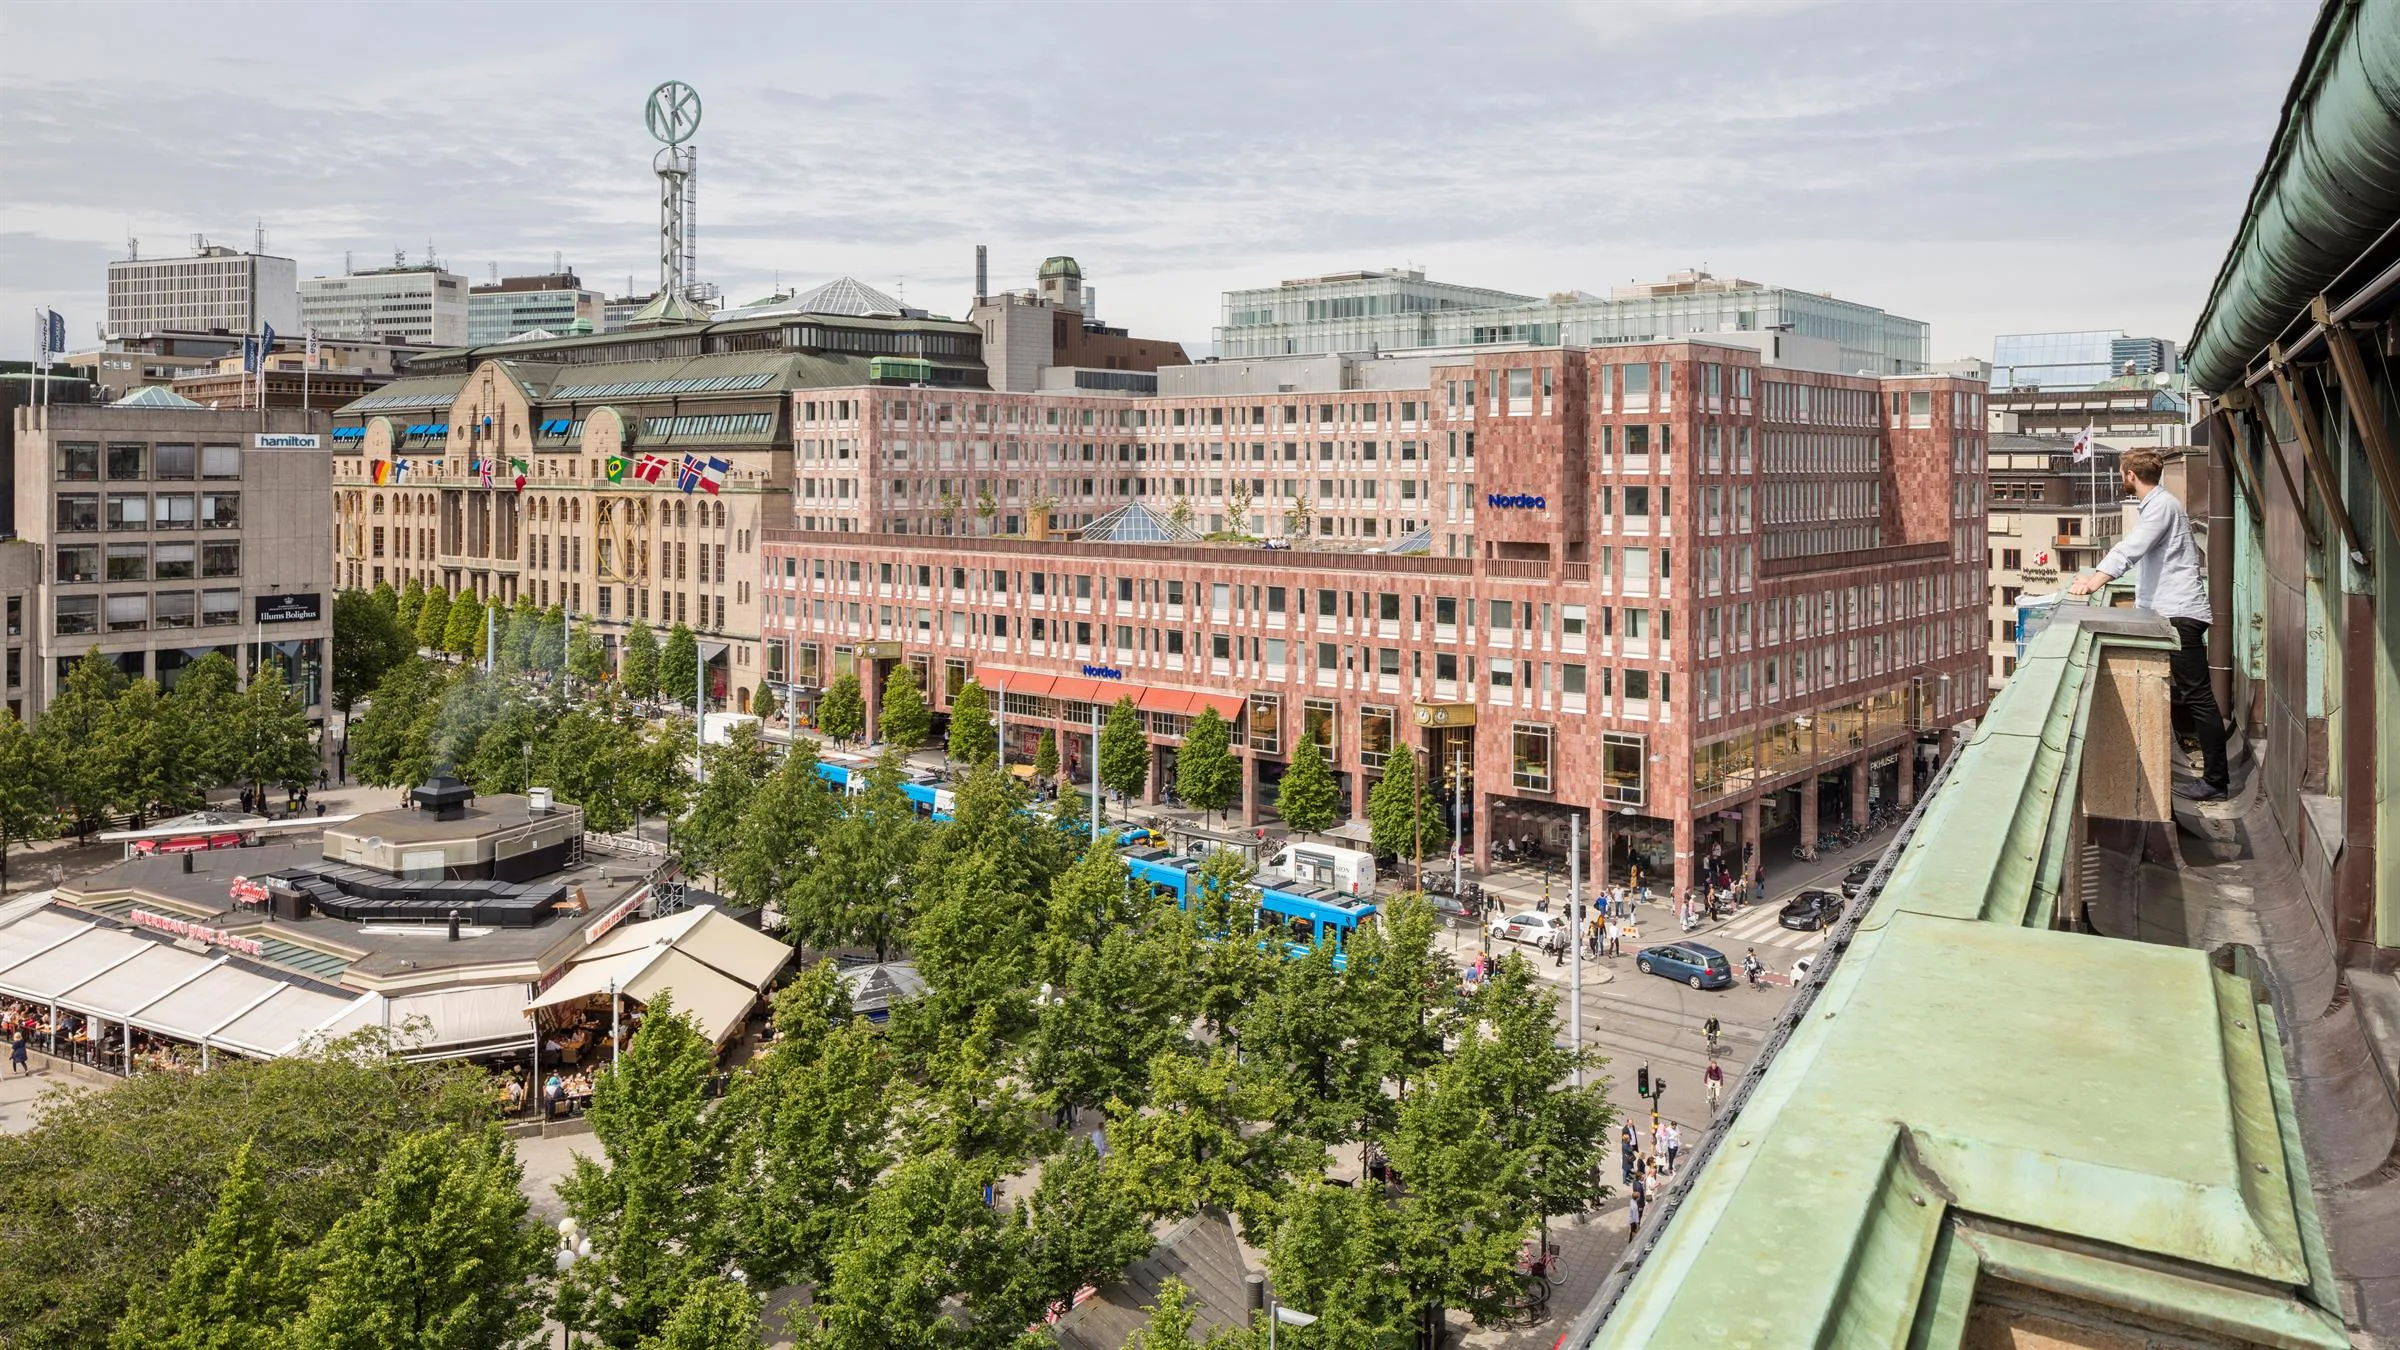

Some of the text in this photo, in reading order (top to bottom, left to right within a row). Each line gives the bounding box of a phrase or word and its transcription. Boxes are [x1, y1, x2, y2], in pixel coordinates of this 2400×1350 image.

[647, 80, 700, 143] NK
[102, 360, 132, 370] SEB
[260, 436, 315, 446] hamilton
[1488, 493, 1546, 509] Nordea
[260, 610, 317, 620] Illums Bolighus
[1083, 664, 1122, 680] Nordea
[1870, 753, 1899, 771] PKHUSET
[620, 900, 635, 919] ALWAYS
[130, 909, 263, 956] AMERICAN BAR & CAFE
